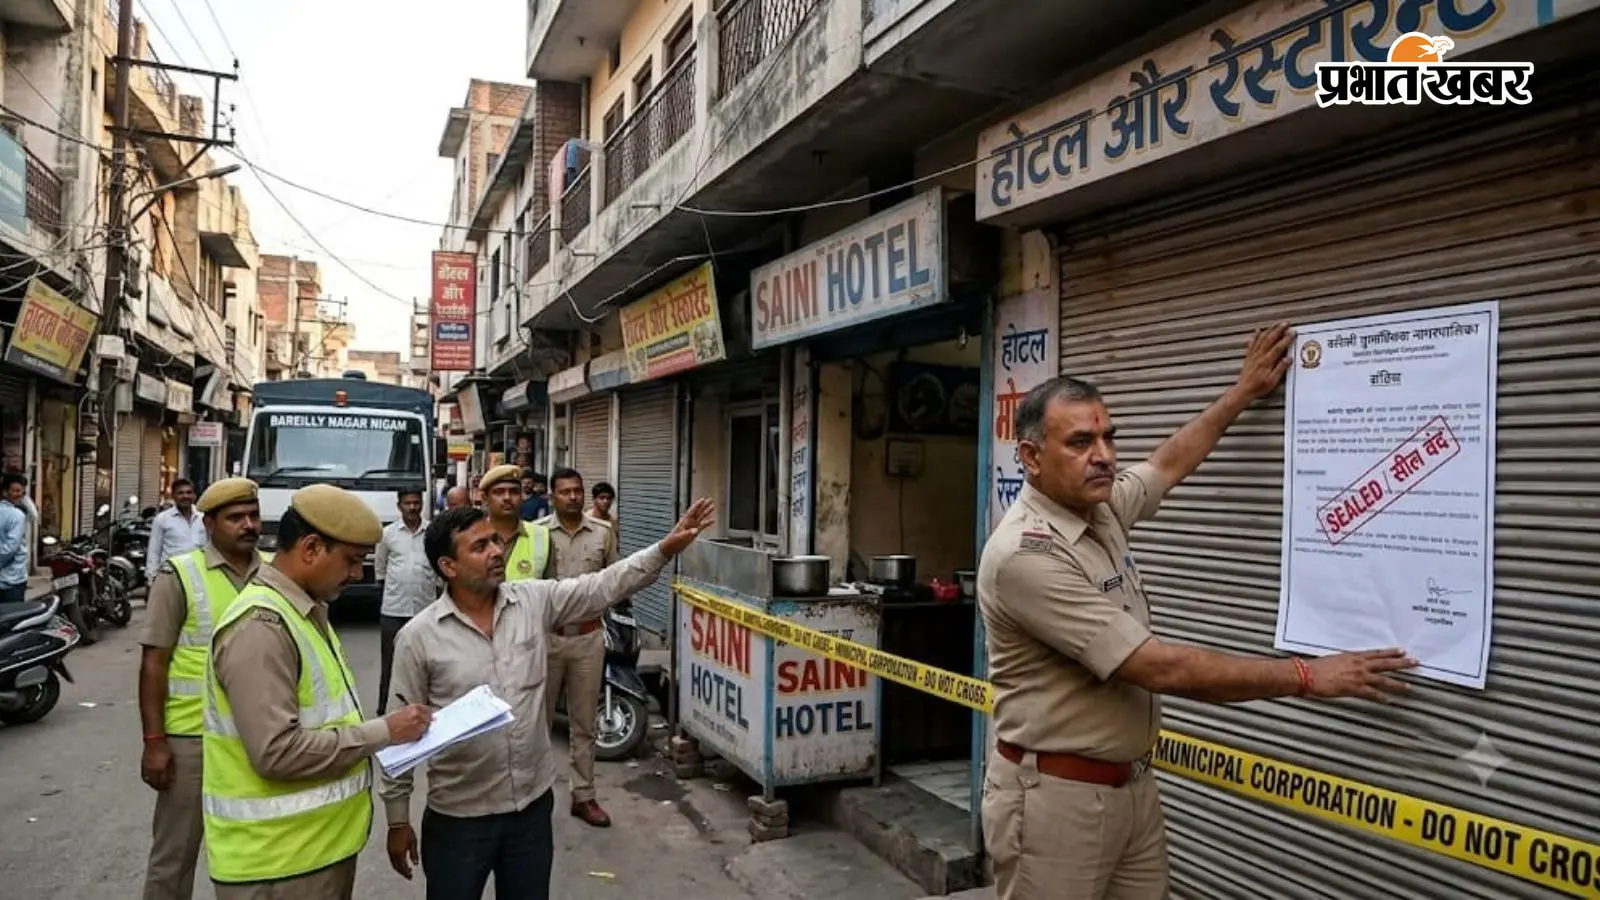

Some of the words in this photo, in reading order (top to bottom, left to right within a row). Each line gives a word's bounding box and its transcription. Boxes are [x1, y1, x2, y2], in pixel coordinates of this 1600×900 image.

[991, 109, 1096, 207] होटल
[1102, 57, 1195, 160] और
[756, 258, 820, 333] SAINI
[827, 219, 930, 312] HOTEL
[1002, 323, 1048, 371] होटल
[270, 415, 325, 428] BAREILLY
[328, 416, 369, 430] NAGAR
[371, 419, 407, 431] NIGAM
[1326, 480, 1384, 534] SEALED
[1390, 449, 1425, 482] सील
[690, 604, 751, 675] SAINI
[691, 663, 749, 729] HOTEL
[775, 700, 873, 738] HOTEL
[1154, 735, 1244, 784] MUNICIPAL
[1250, 762, 1397, 829] CORPORATION
[1421, 810, 1456, 847] DO
[1464, 823, 1521, 865] NOT
[1529, 838, 1600, 893] CRO
